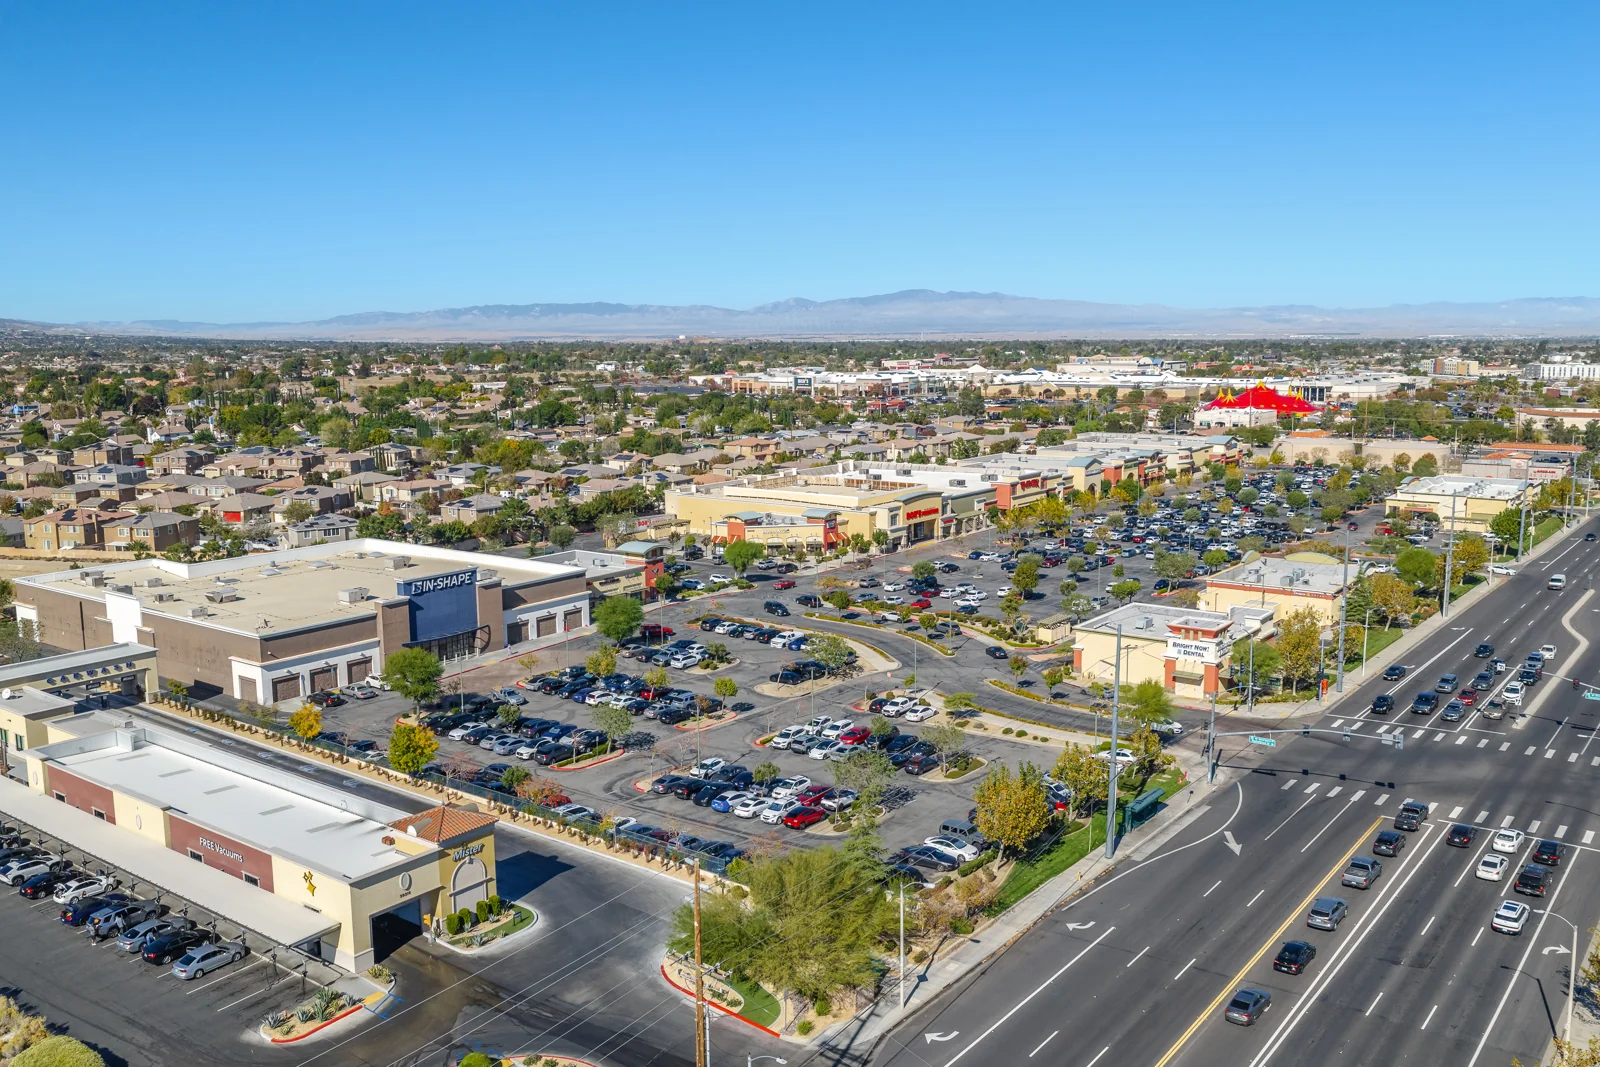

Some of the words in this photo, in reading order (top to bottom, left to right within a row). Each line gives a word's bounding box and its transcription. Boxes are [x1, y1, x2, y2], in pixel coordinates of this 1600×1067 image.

[422, 572, 472, 592] IN-SHAPE
[1183, 649, 1205, 658] DENTAL
[199, 836, 215, 851] FREE
[214, 843, 243, 863] Vacuums
[453, 843, 483, 861] Mister
